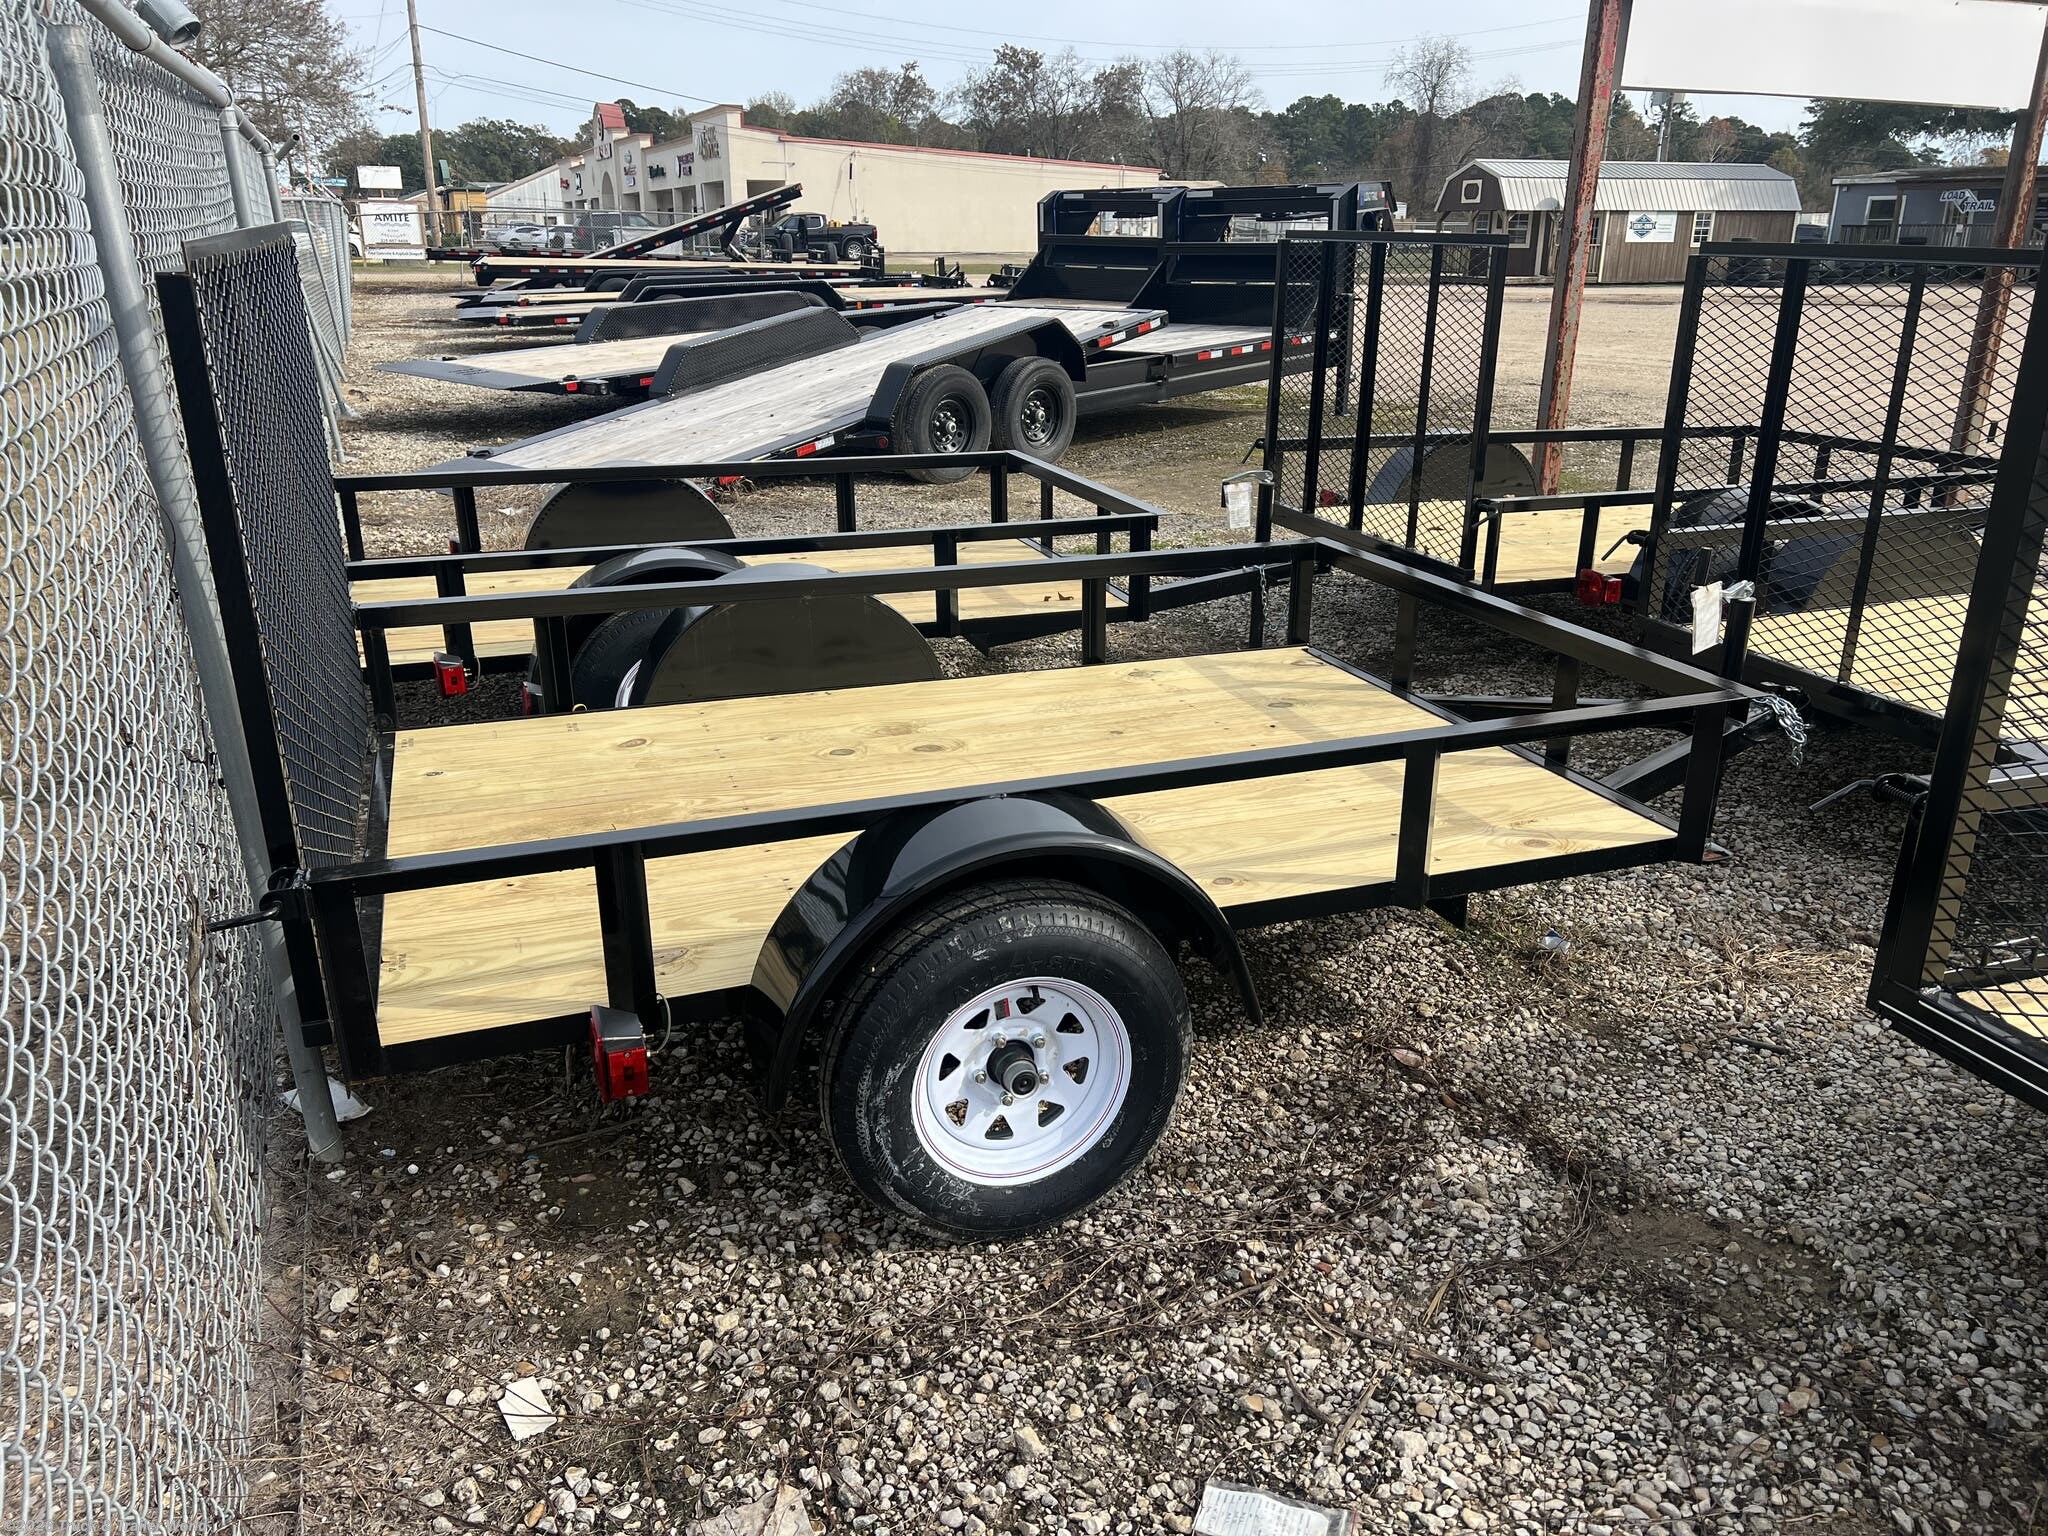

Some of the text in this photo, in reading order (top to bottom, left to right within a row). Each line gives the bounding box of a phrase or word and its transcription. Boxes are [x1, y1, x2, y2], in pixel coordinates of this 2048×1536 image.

[1941, 191, 1965, 200] LOAD
[1965, 201, 1994, 210] TRAIL
[374, 213, 410, 222] AMITE
